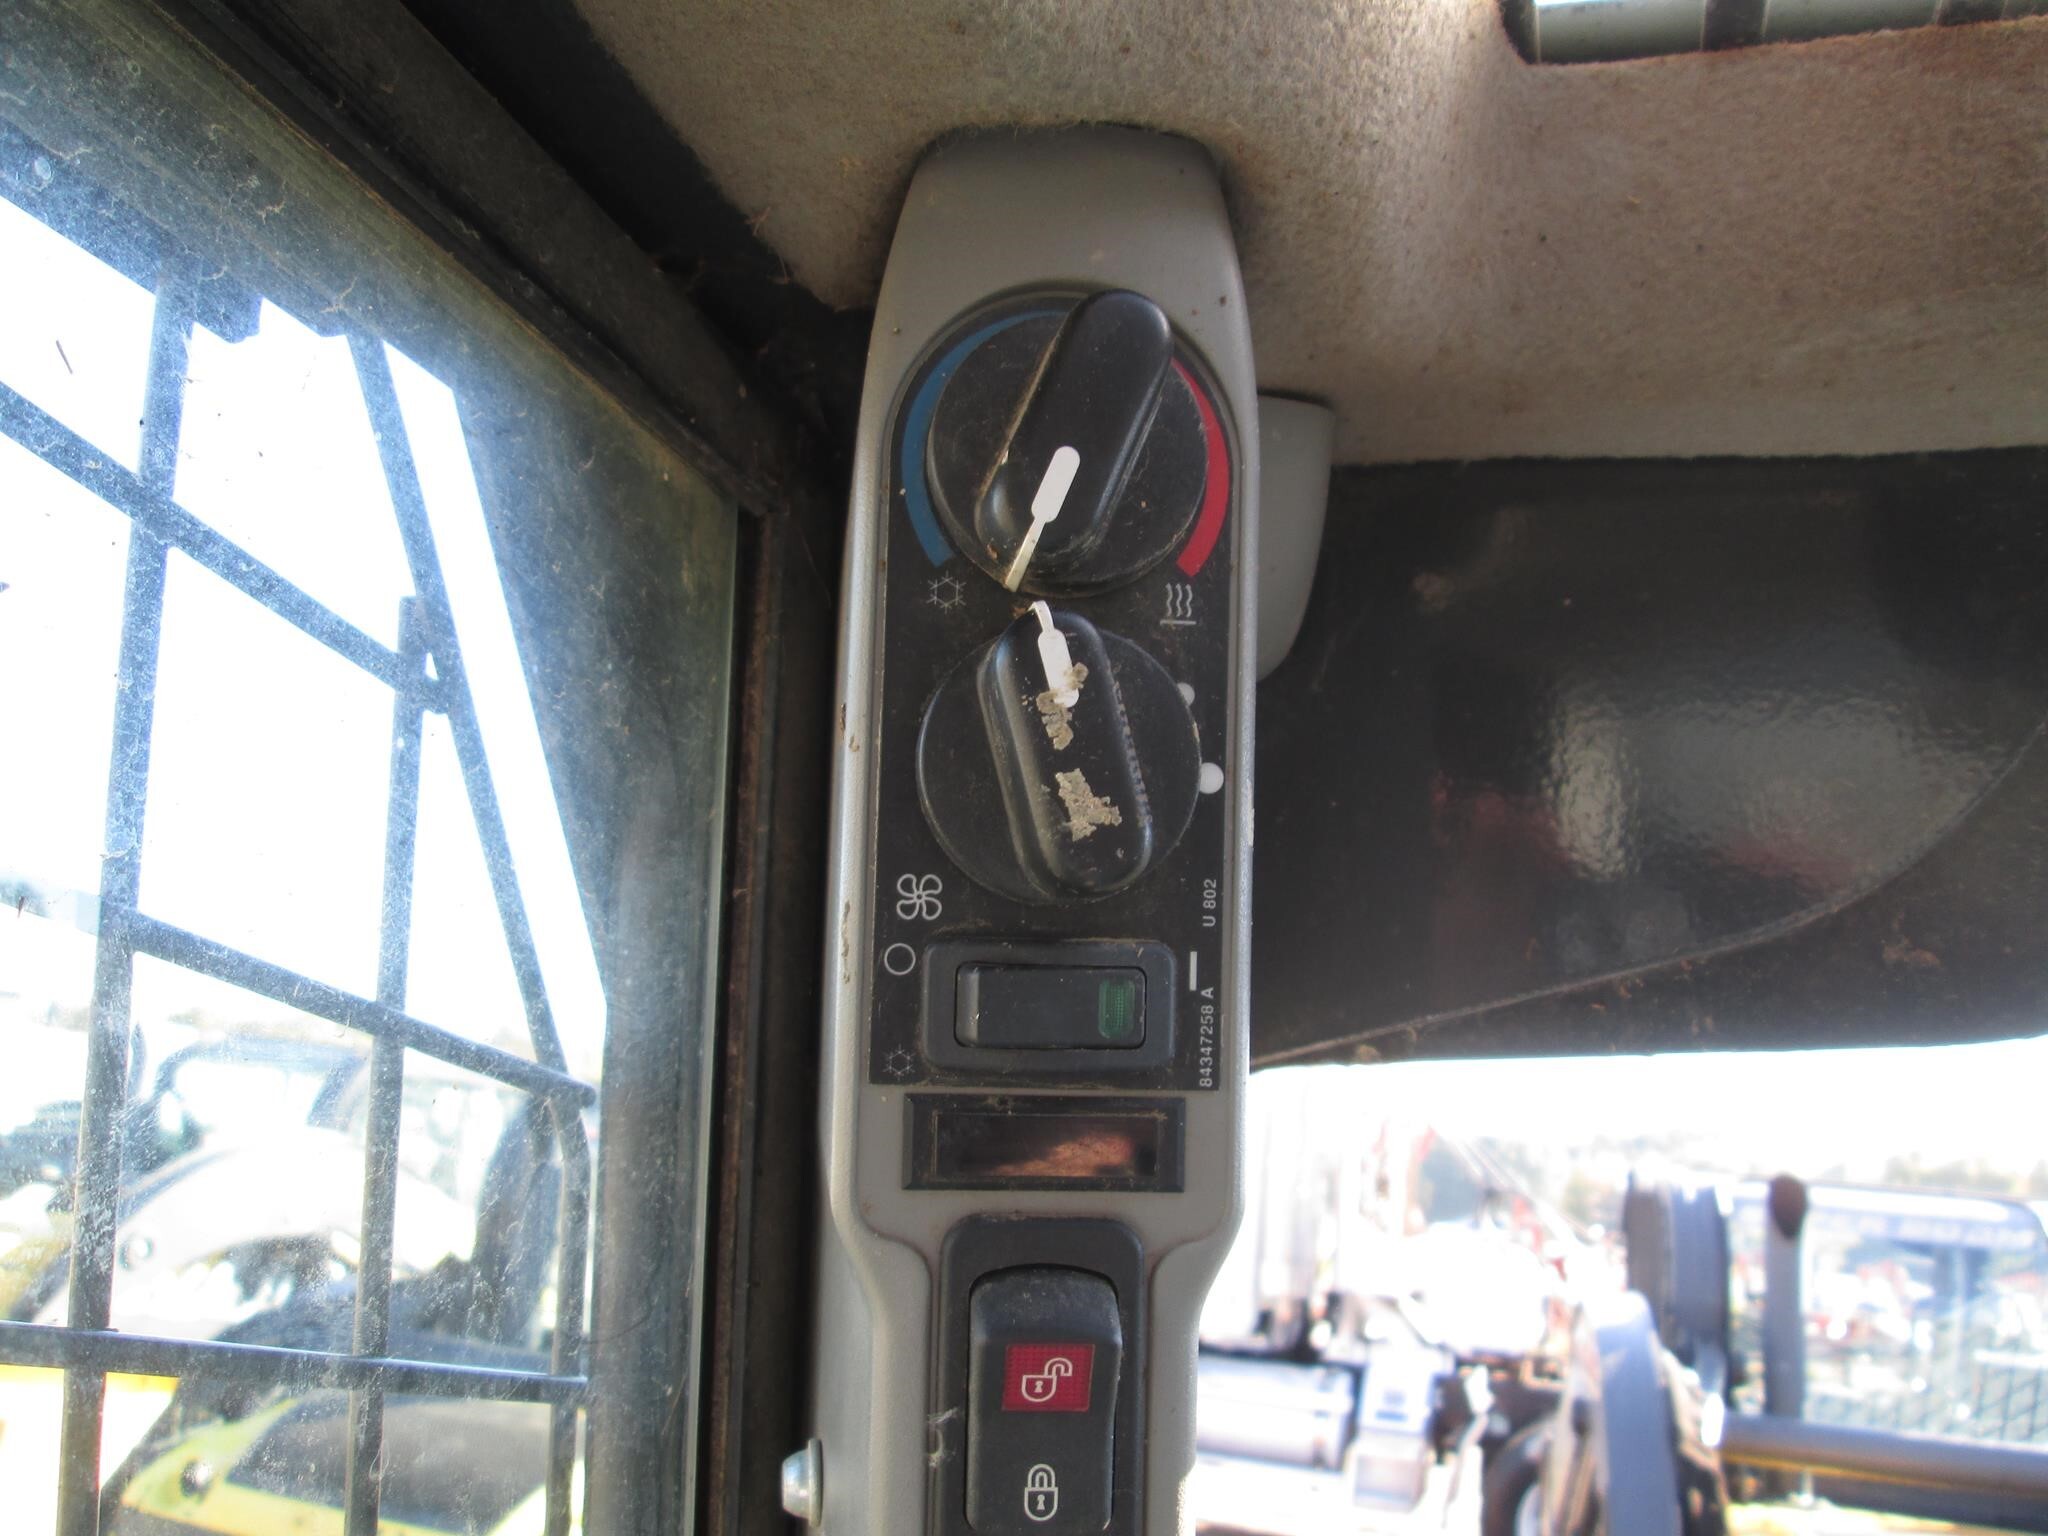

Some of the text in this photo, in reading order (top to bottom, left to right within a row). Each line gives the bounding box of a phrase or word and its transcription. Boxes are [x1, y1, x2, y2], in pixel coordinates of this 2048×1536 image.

[1202, 879, 1217, 927] U 802
[1200, 987, 1214, 1087] 84347258 A
